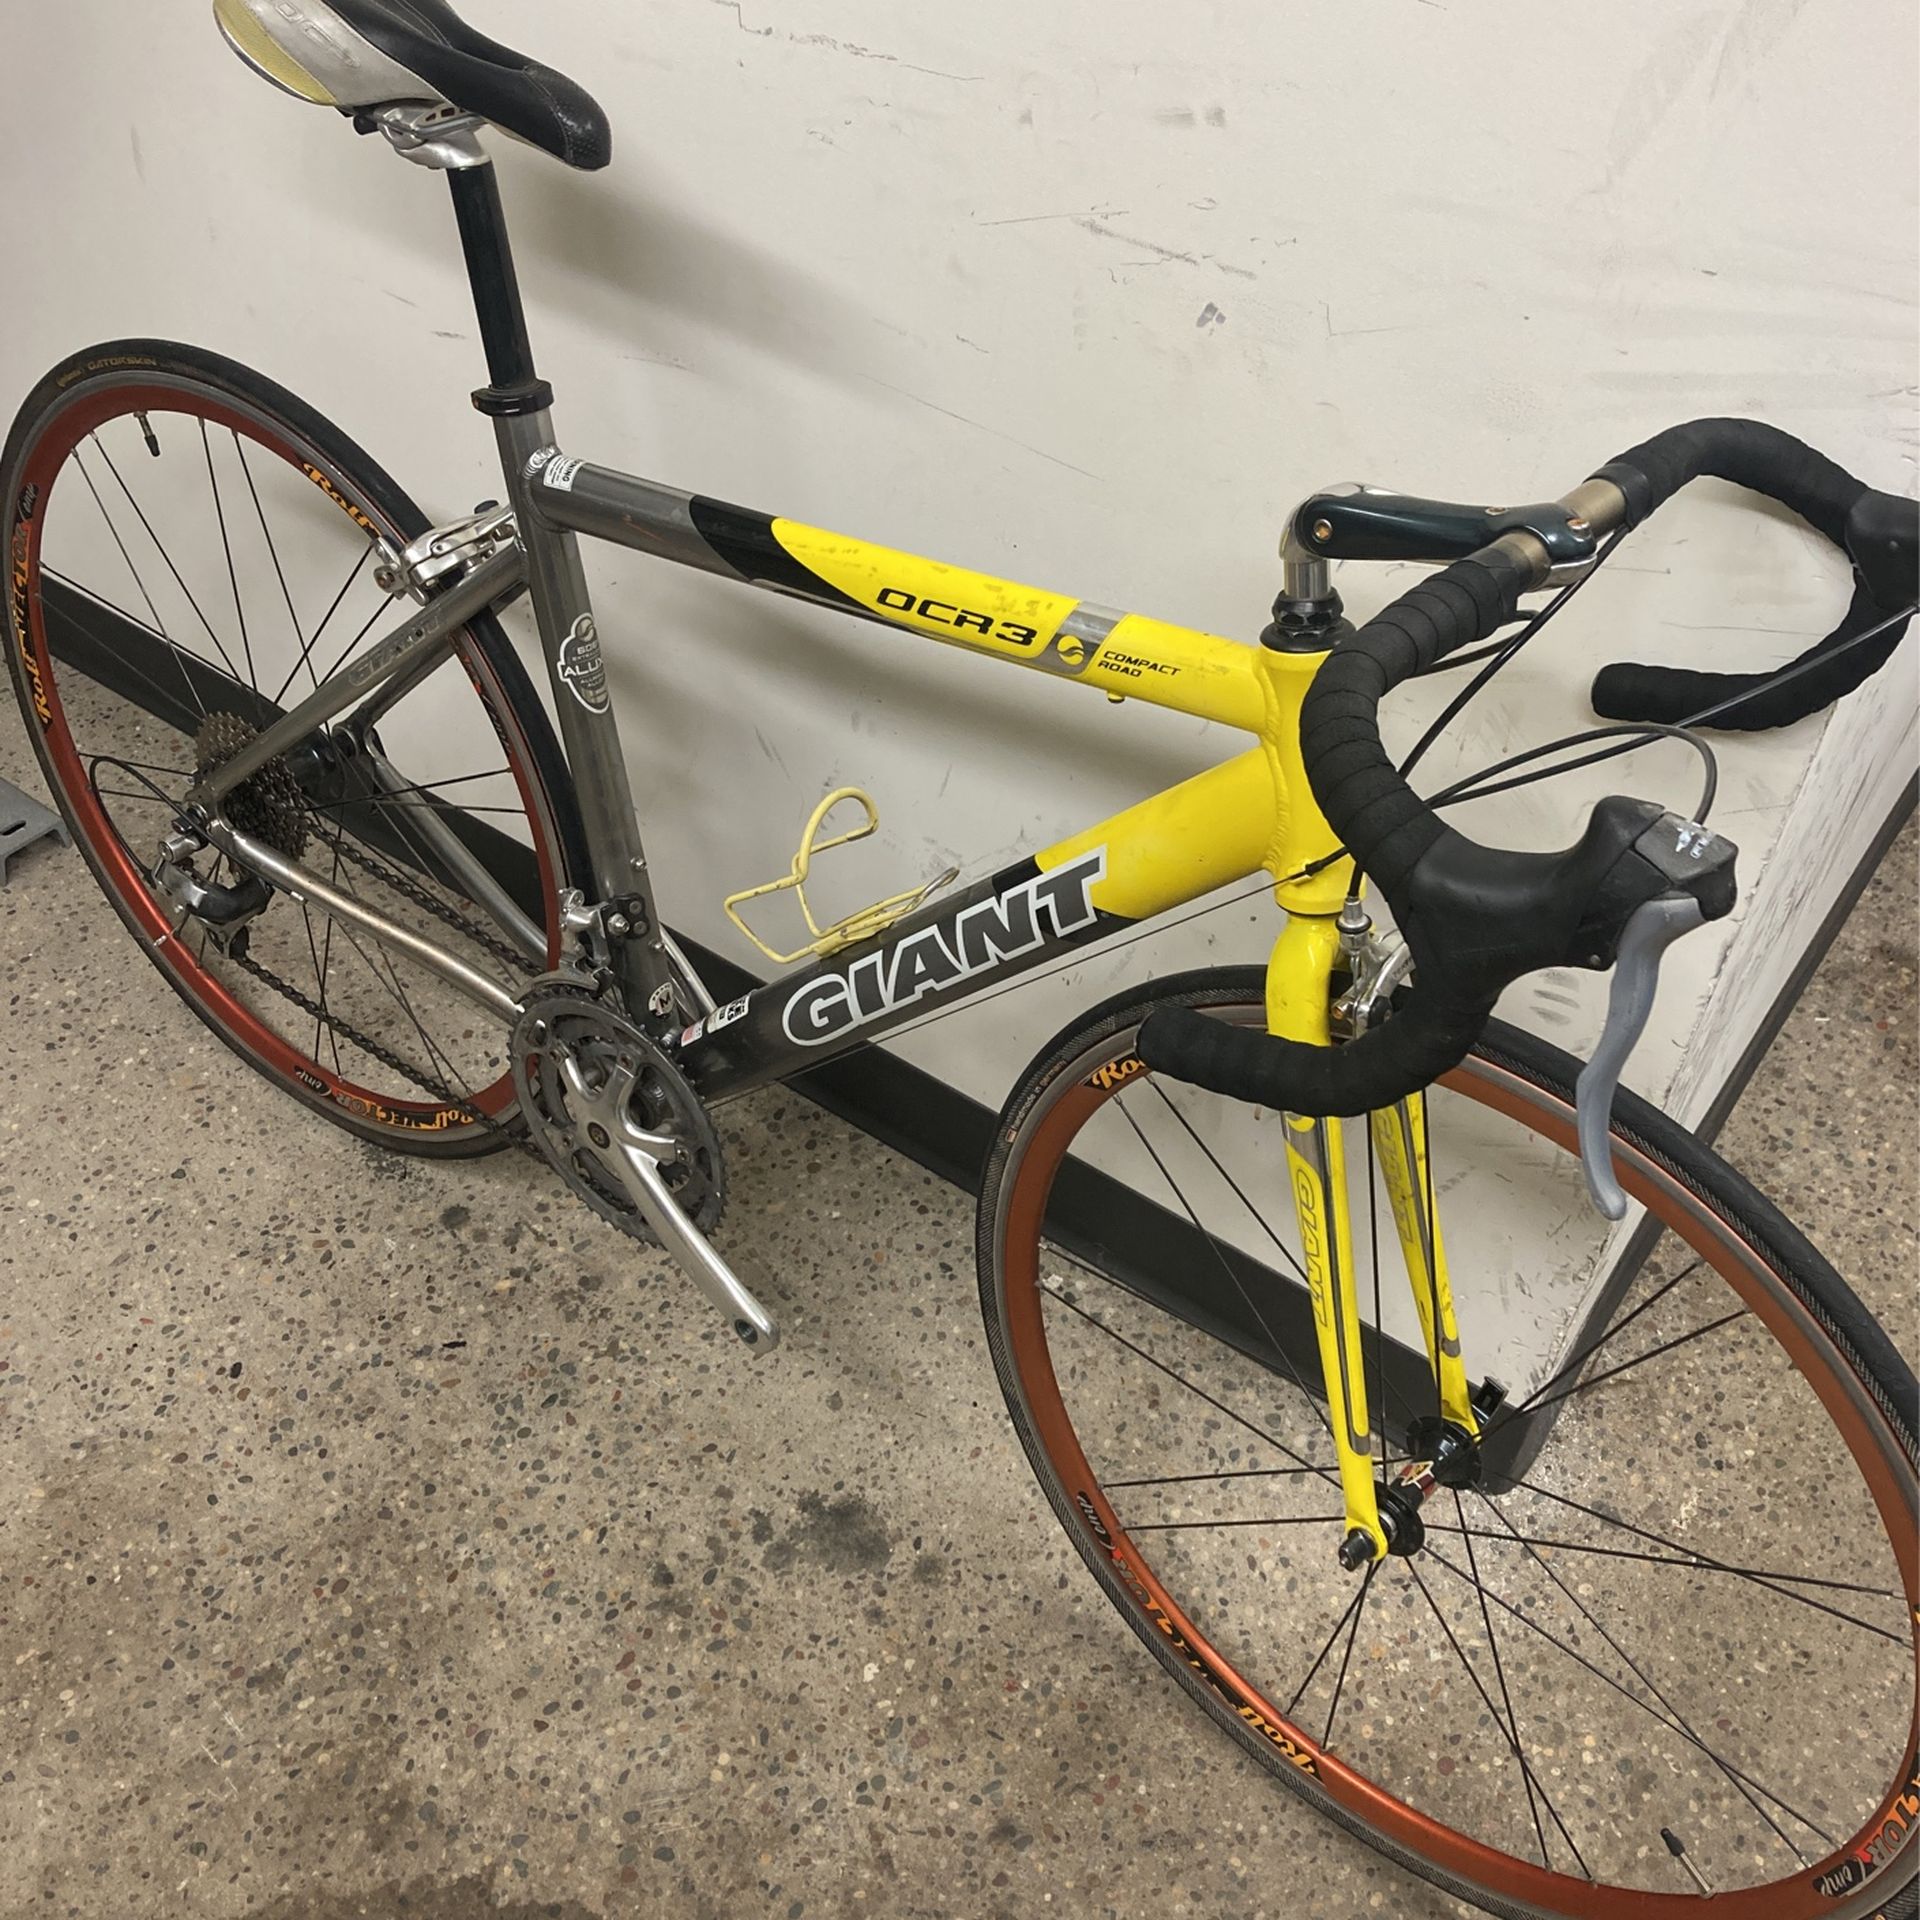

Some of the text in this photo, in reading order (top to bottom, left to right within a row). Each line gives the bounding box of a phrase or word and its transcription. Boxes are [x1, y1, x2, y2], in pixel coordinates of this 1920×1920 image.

[1097, 660, 1142, 678] ROAD
[1103, 650, 1181, 677] COMPACT
[782, 842, 1107, 1046] GIANT
[1296, 1167, 1328, 1328] GIANT
[1076, 1493, 1116, 1551] Comp
[1235, 1703, 1317, 1776] Rolf
[1820, 1855, 1868, 1897] Comp
